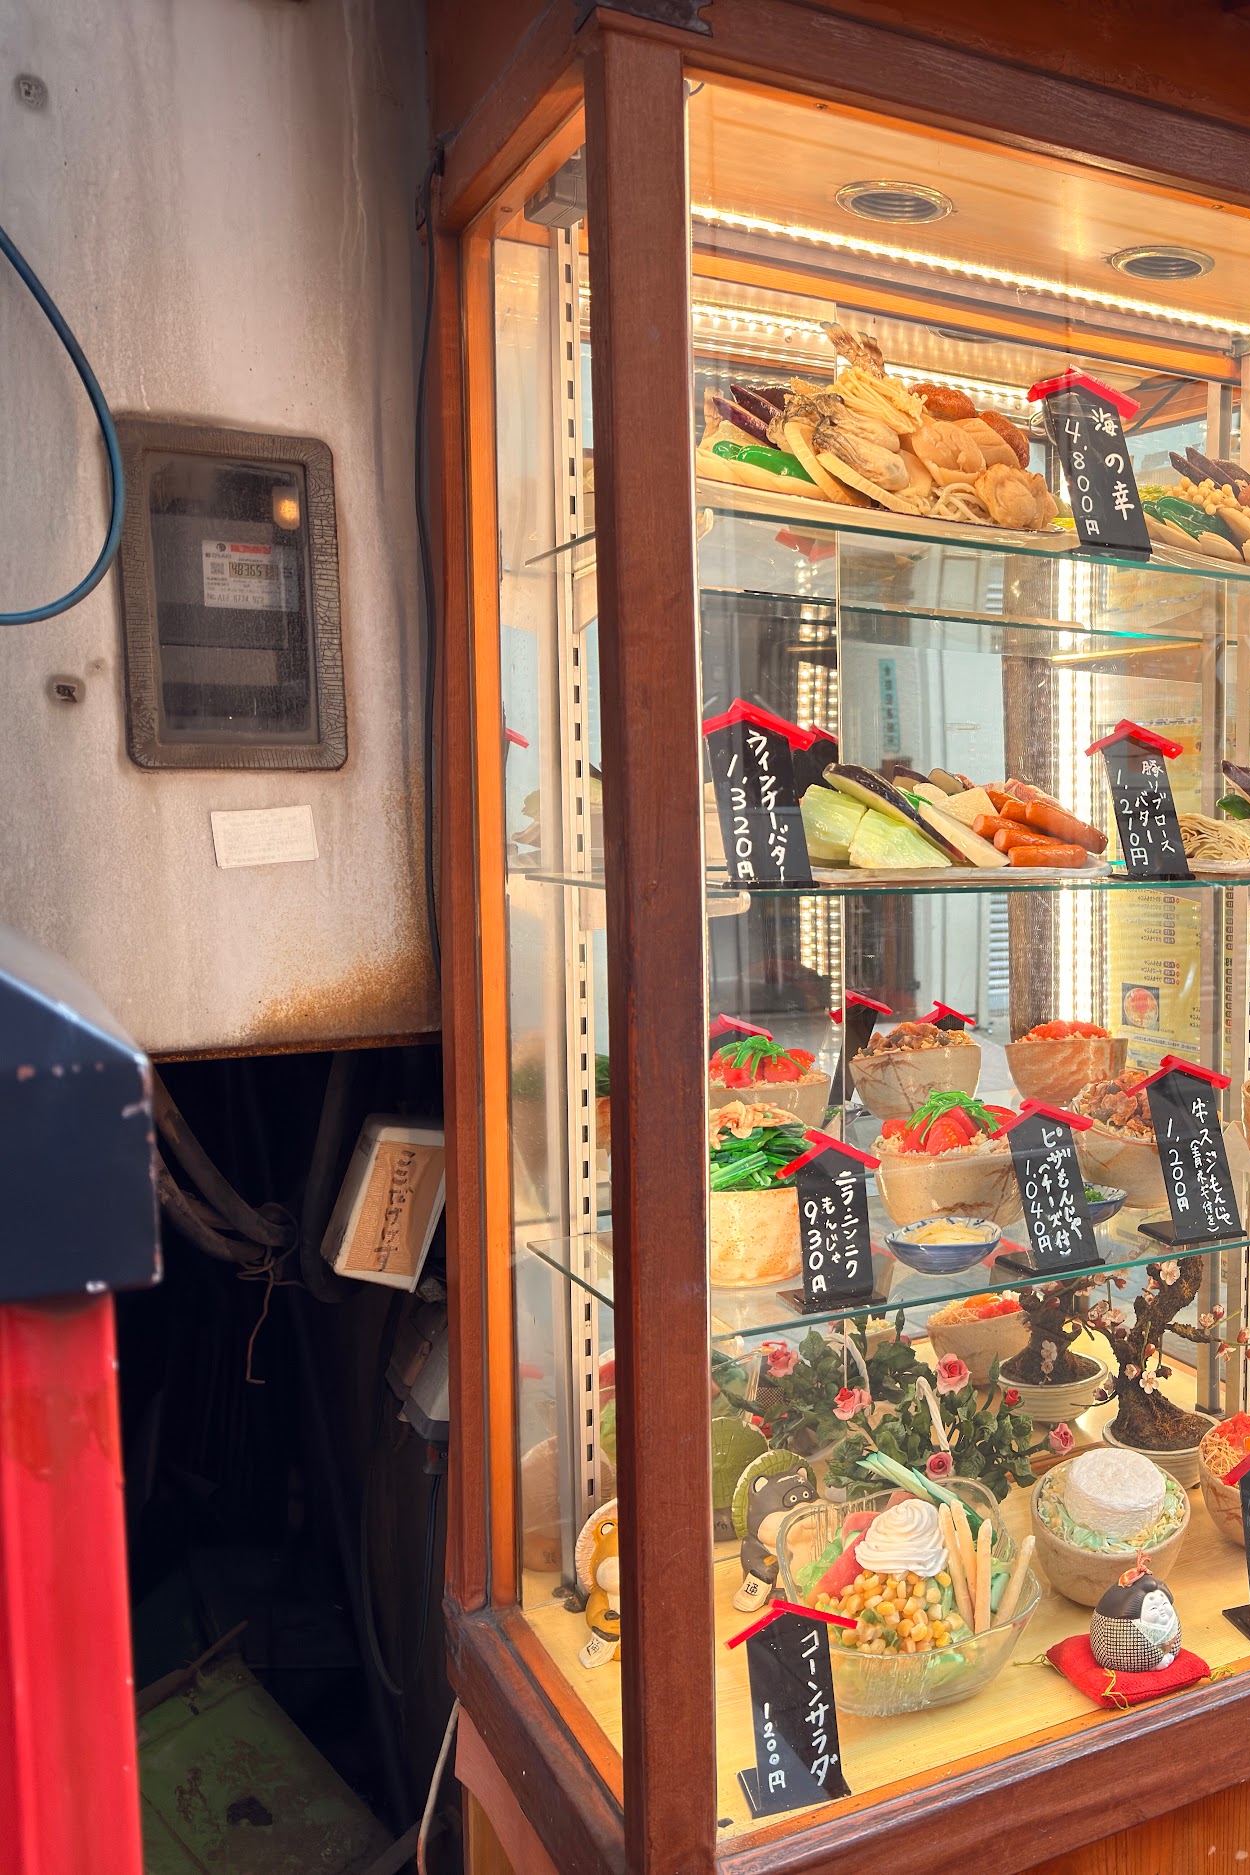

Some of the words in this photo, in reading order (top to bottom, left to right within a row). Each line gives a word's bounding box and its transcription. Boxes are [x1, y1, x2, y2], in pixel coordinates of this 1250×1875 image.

[1091, 407, 1134, 521] 海の幸
[821, 1197, 841, 1264] もんじゃ
[1042, 1127, 1082, 1239] ピザもんじゃ
[804, 1201, 827, 1293] 930円
[801, 1629, 839, 1787] コーンサラダ
